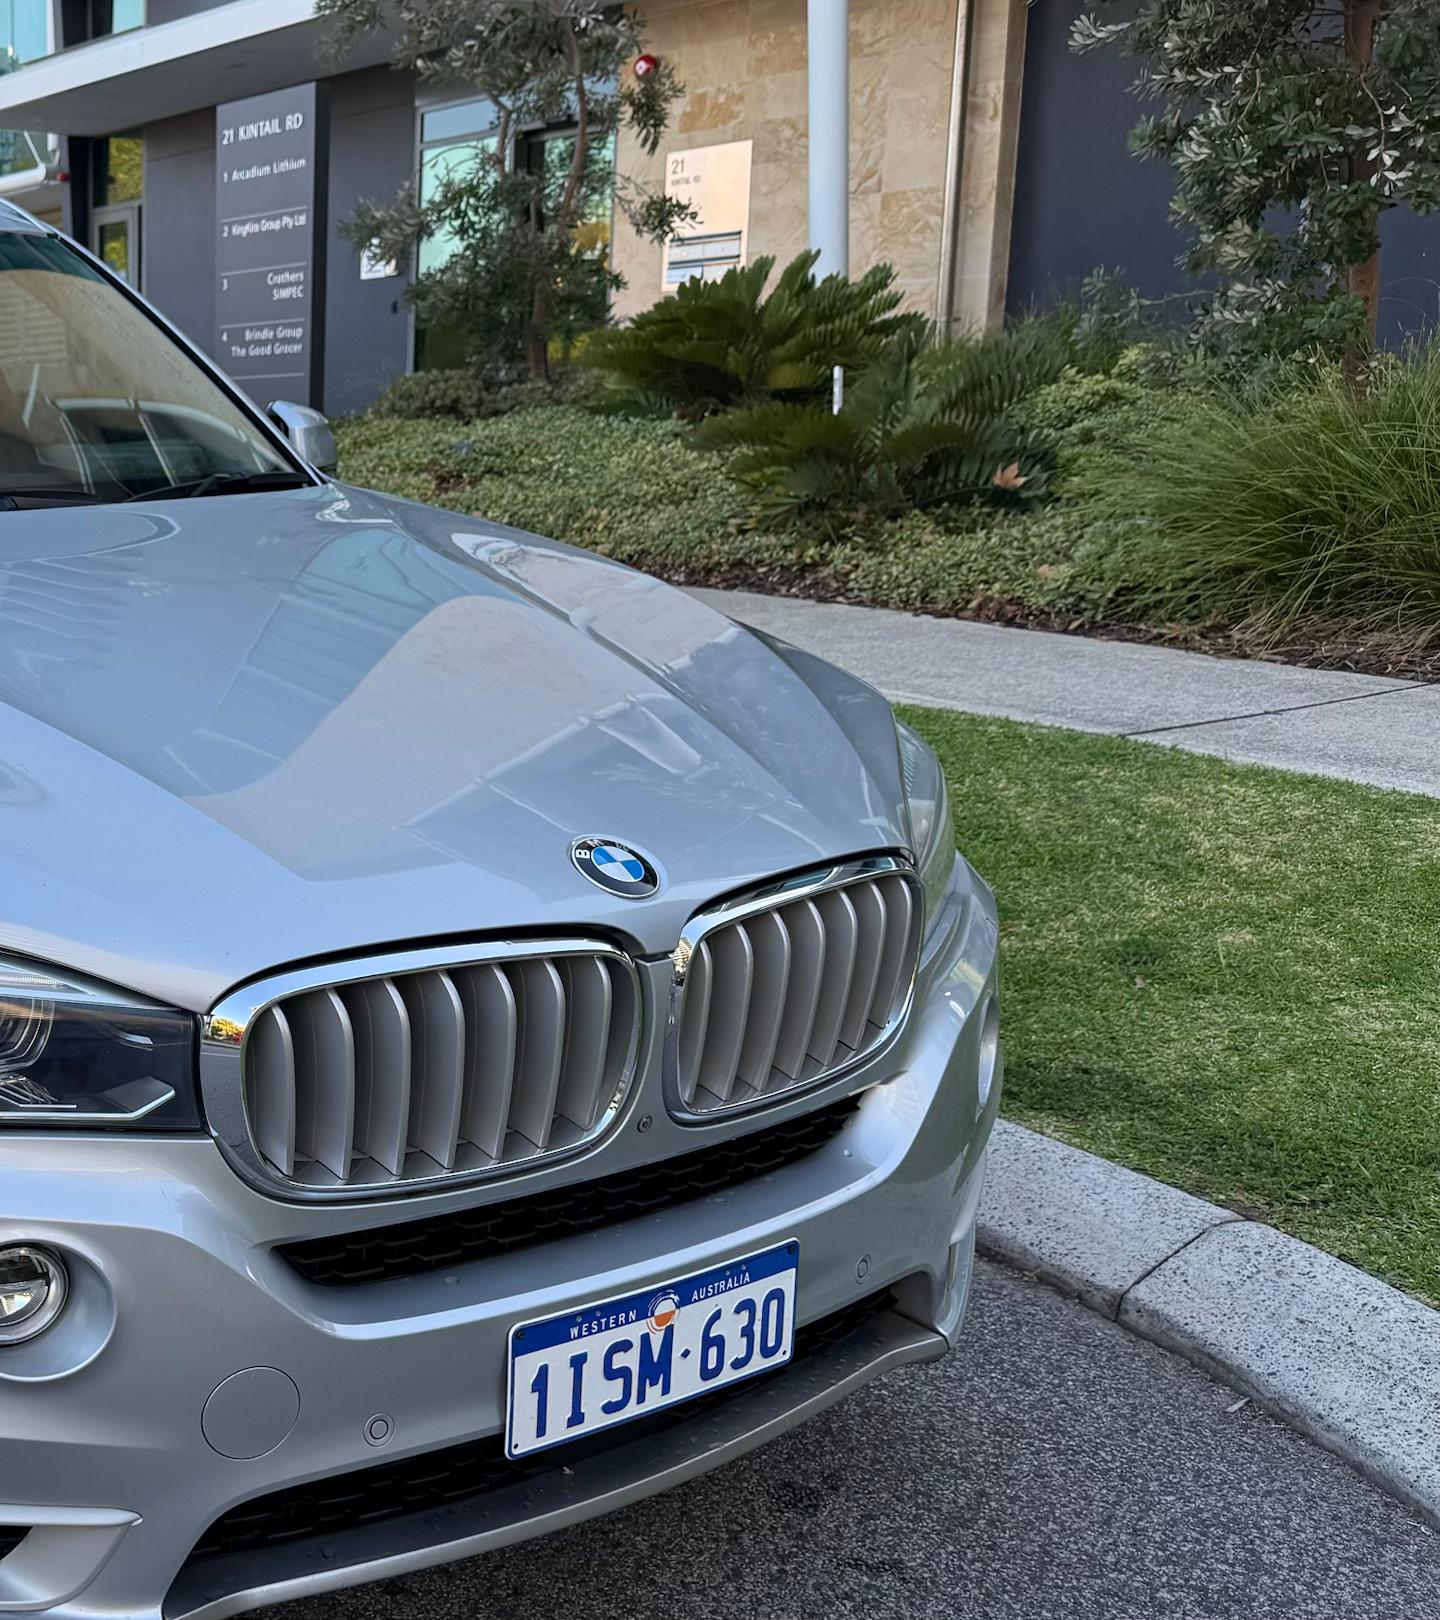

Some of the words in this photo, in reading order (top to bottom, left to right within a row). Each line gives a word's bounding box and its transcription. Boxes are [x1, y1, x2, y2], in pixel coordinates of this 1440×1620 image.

[222, 128, 234, 145] 21
[239, 118, 281, 141] KINTAIL
[285, 112, 304, 131] RD
[223, 171, 228, 183] 1
[231, 165, 271, 181] Arcadium
[273, 158, 306, 174] Lithium
[671, 159, 684, 175] 21
[222, 225, 229, 237] 2
[281, 215, 293, 230] Pty
[294, 212, 307, 226] Ltd
[222, 278, 228, 291] 3
[221, 331, 228, 342] 4
[245, 327, 274, 341] Brindle
[276, 326, 303, 339] Group
[231, 345, 246, 357] The
[248, 343, 272, 356] Good
[273, 342, 302, 355] Grocer
[570, 1310, 637, 1339] WESTERN
[691, 1272, 751, 1302] AUSTRALIA
